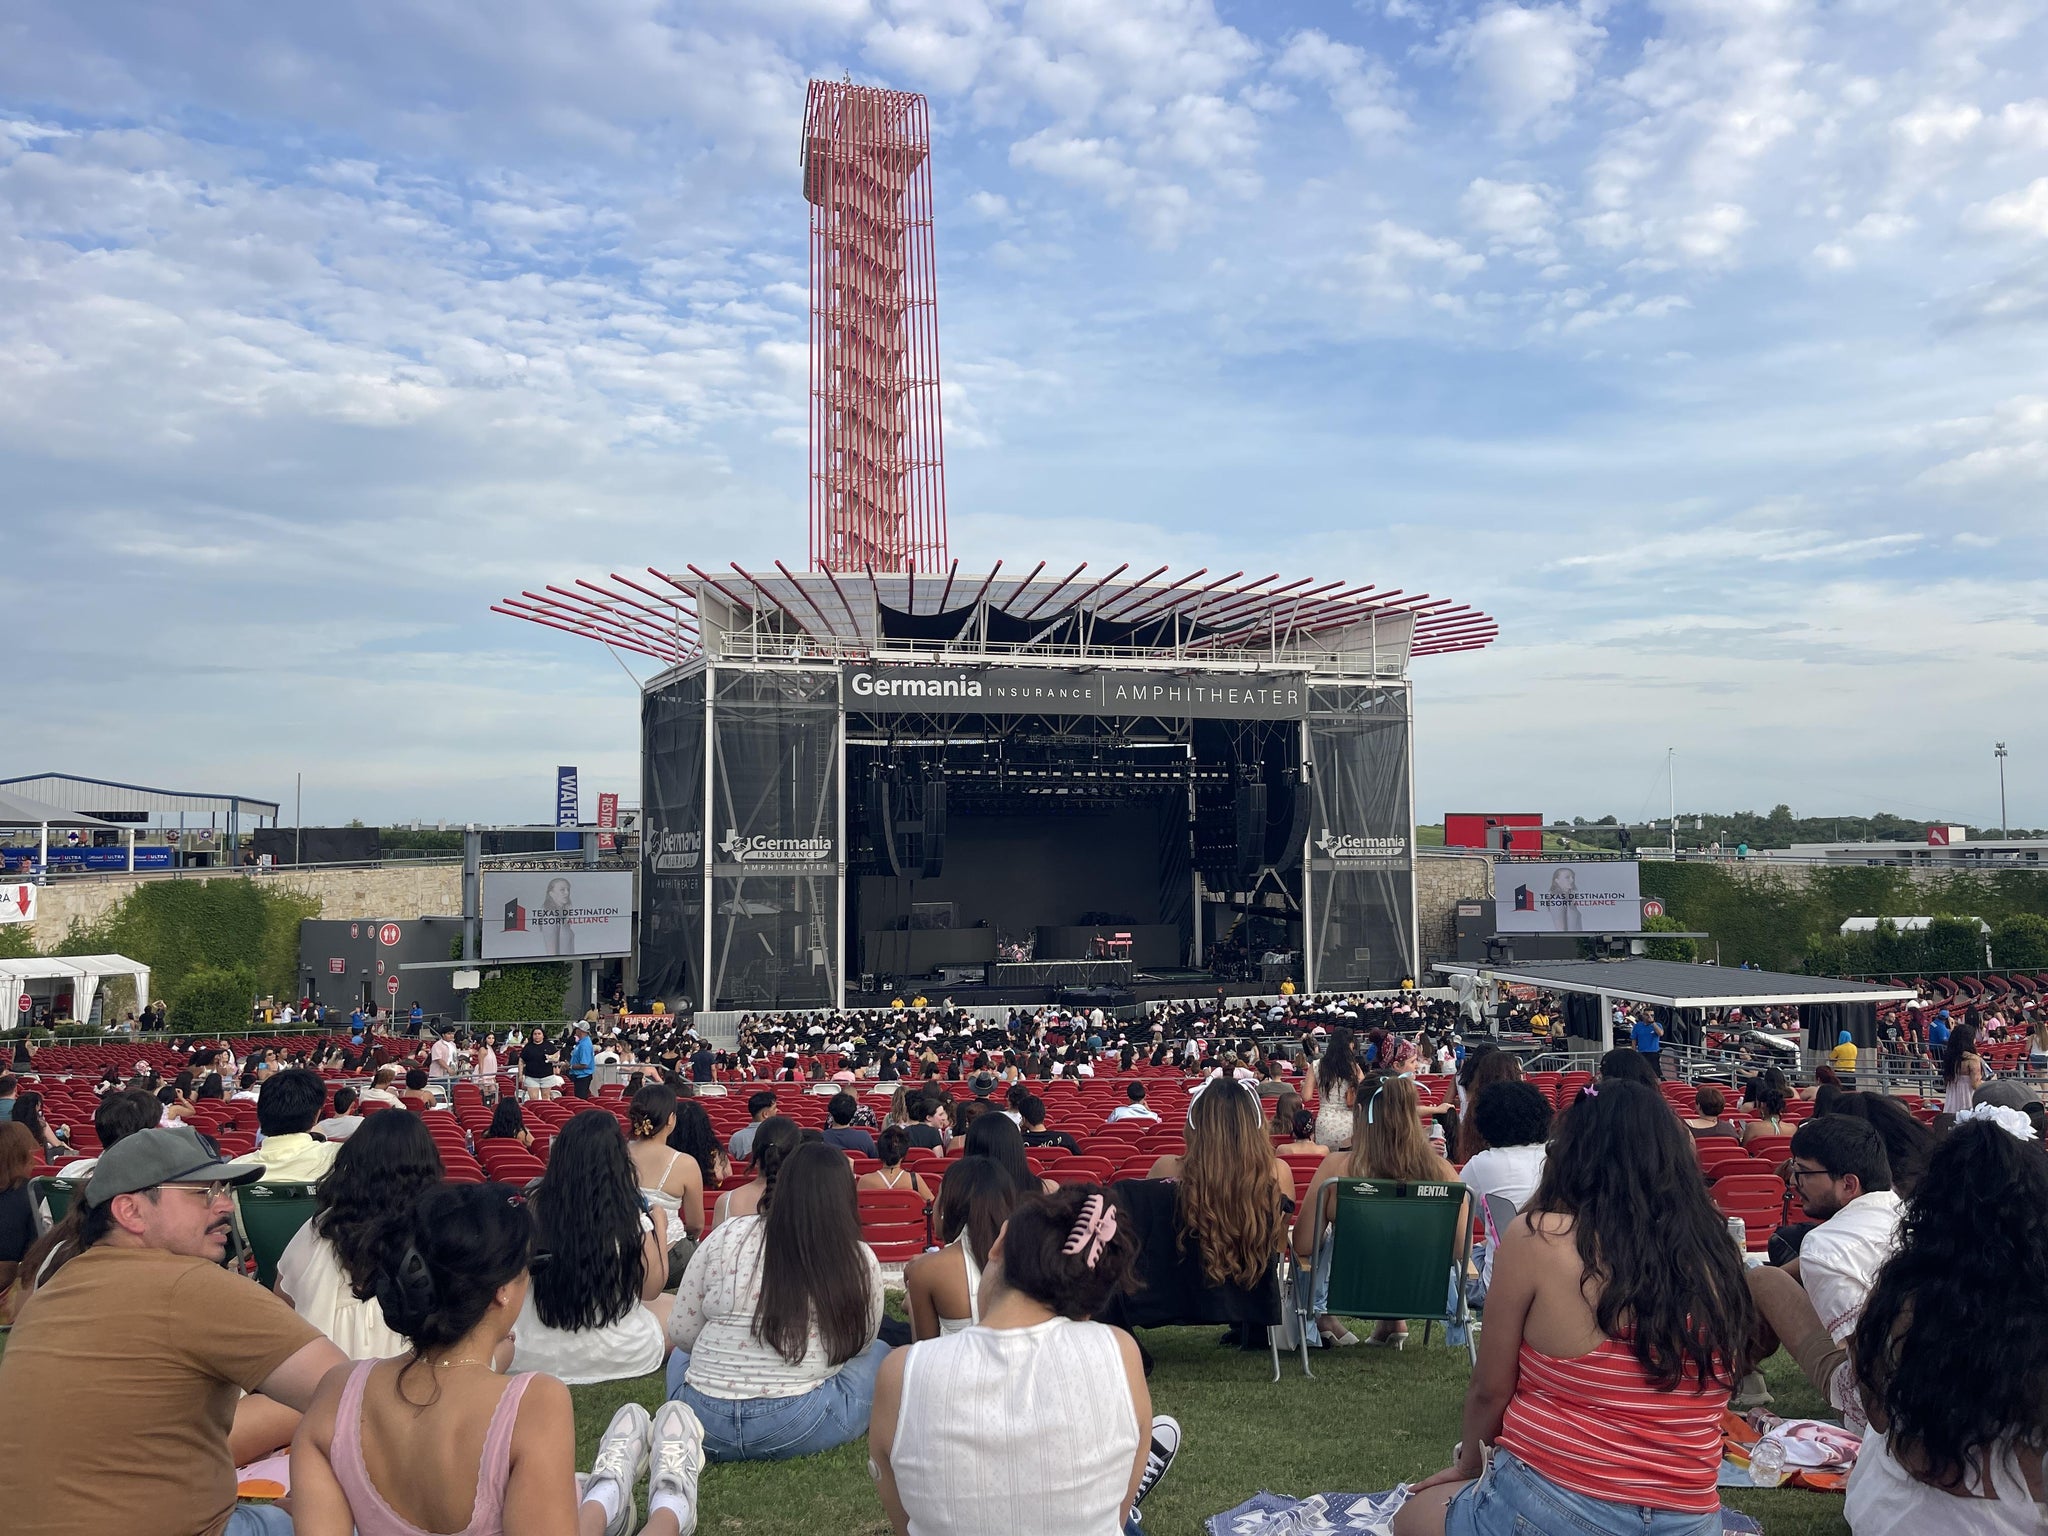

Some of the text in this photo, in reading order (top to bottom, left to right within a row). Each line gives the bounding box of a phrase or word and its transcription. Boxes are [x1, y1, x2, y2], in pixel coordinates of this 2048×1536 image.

[852, 673, 1298, 705] Germania INSURANCE AMPHITHEATER
[560, 775, 577, 828] WATER
[601, 797, 613, 846] RESTROMS
[752, 835, 832, 850] Germania
[1341, 834, 1406, 848] Germania
[1568, 892, 1625, 900] DESTINATION
[532, 907, 619, 918] TEXAS DESTINATION
[532, 915, 609, 926] RESORT ALLIANCE
[1417, 1186, 1449, 1197] RENTAL
